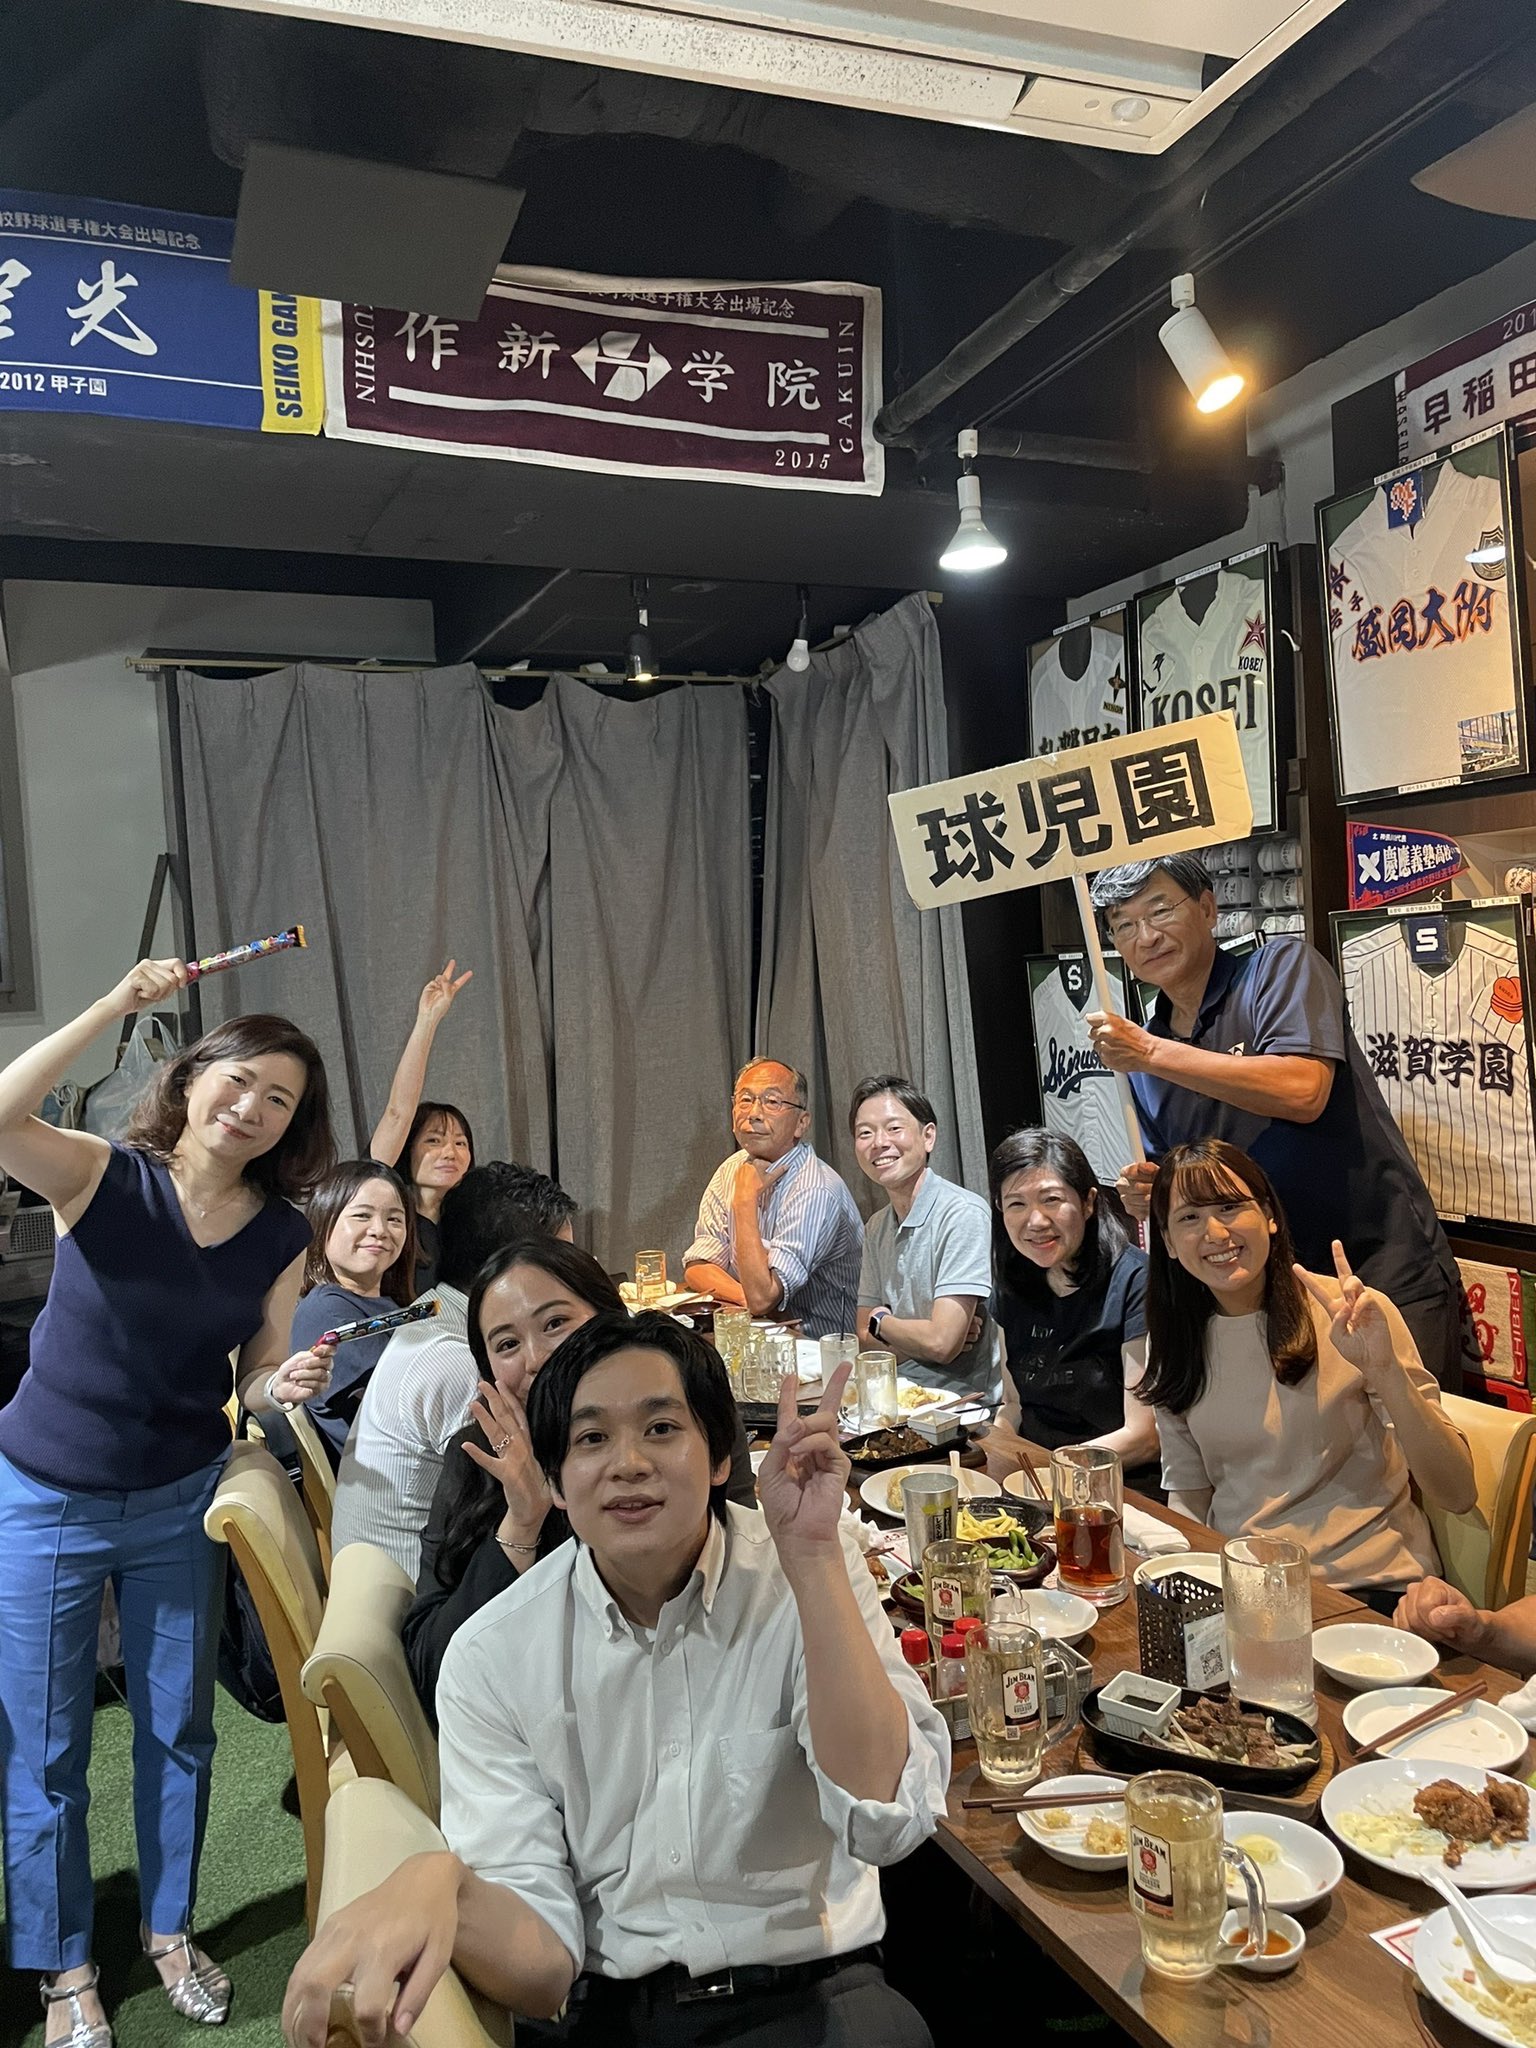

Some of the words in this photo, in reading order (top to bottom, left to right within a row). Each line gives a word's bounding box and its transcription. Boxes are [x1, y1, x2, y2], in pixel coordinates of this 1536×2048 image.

[0, 211, 201, 250] 校野球選手権大会出場記念
[0, 373, 45, 392] 2012
[51, 376, 107, 396] 甲子園
[273, 343, 303, 418] SEIKO
[353, 303, 376, 404] USHIN
[838, 321, 855, 453] GAKUIN
[1424, 352, 1536, 435] 早稲田
[775, 450, 831, 470] 2015
[916, 738, 1215, 888] 球児園
[1416, 927, 1438, 952] S
[1067, 964, 1082, 991] S
[1367, 1032, 1514, 1097] 滋賀学園
[1509, 1277, 1524, 1376] CHIBEN
